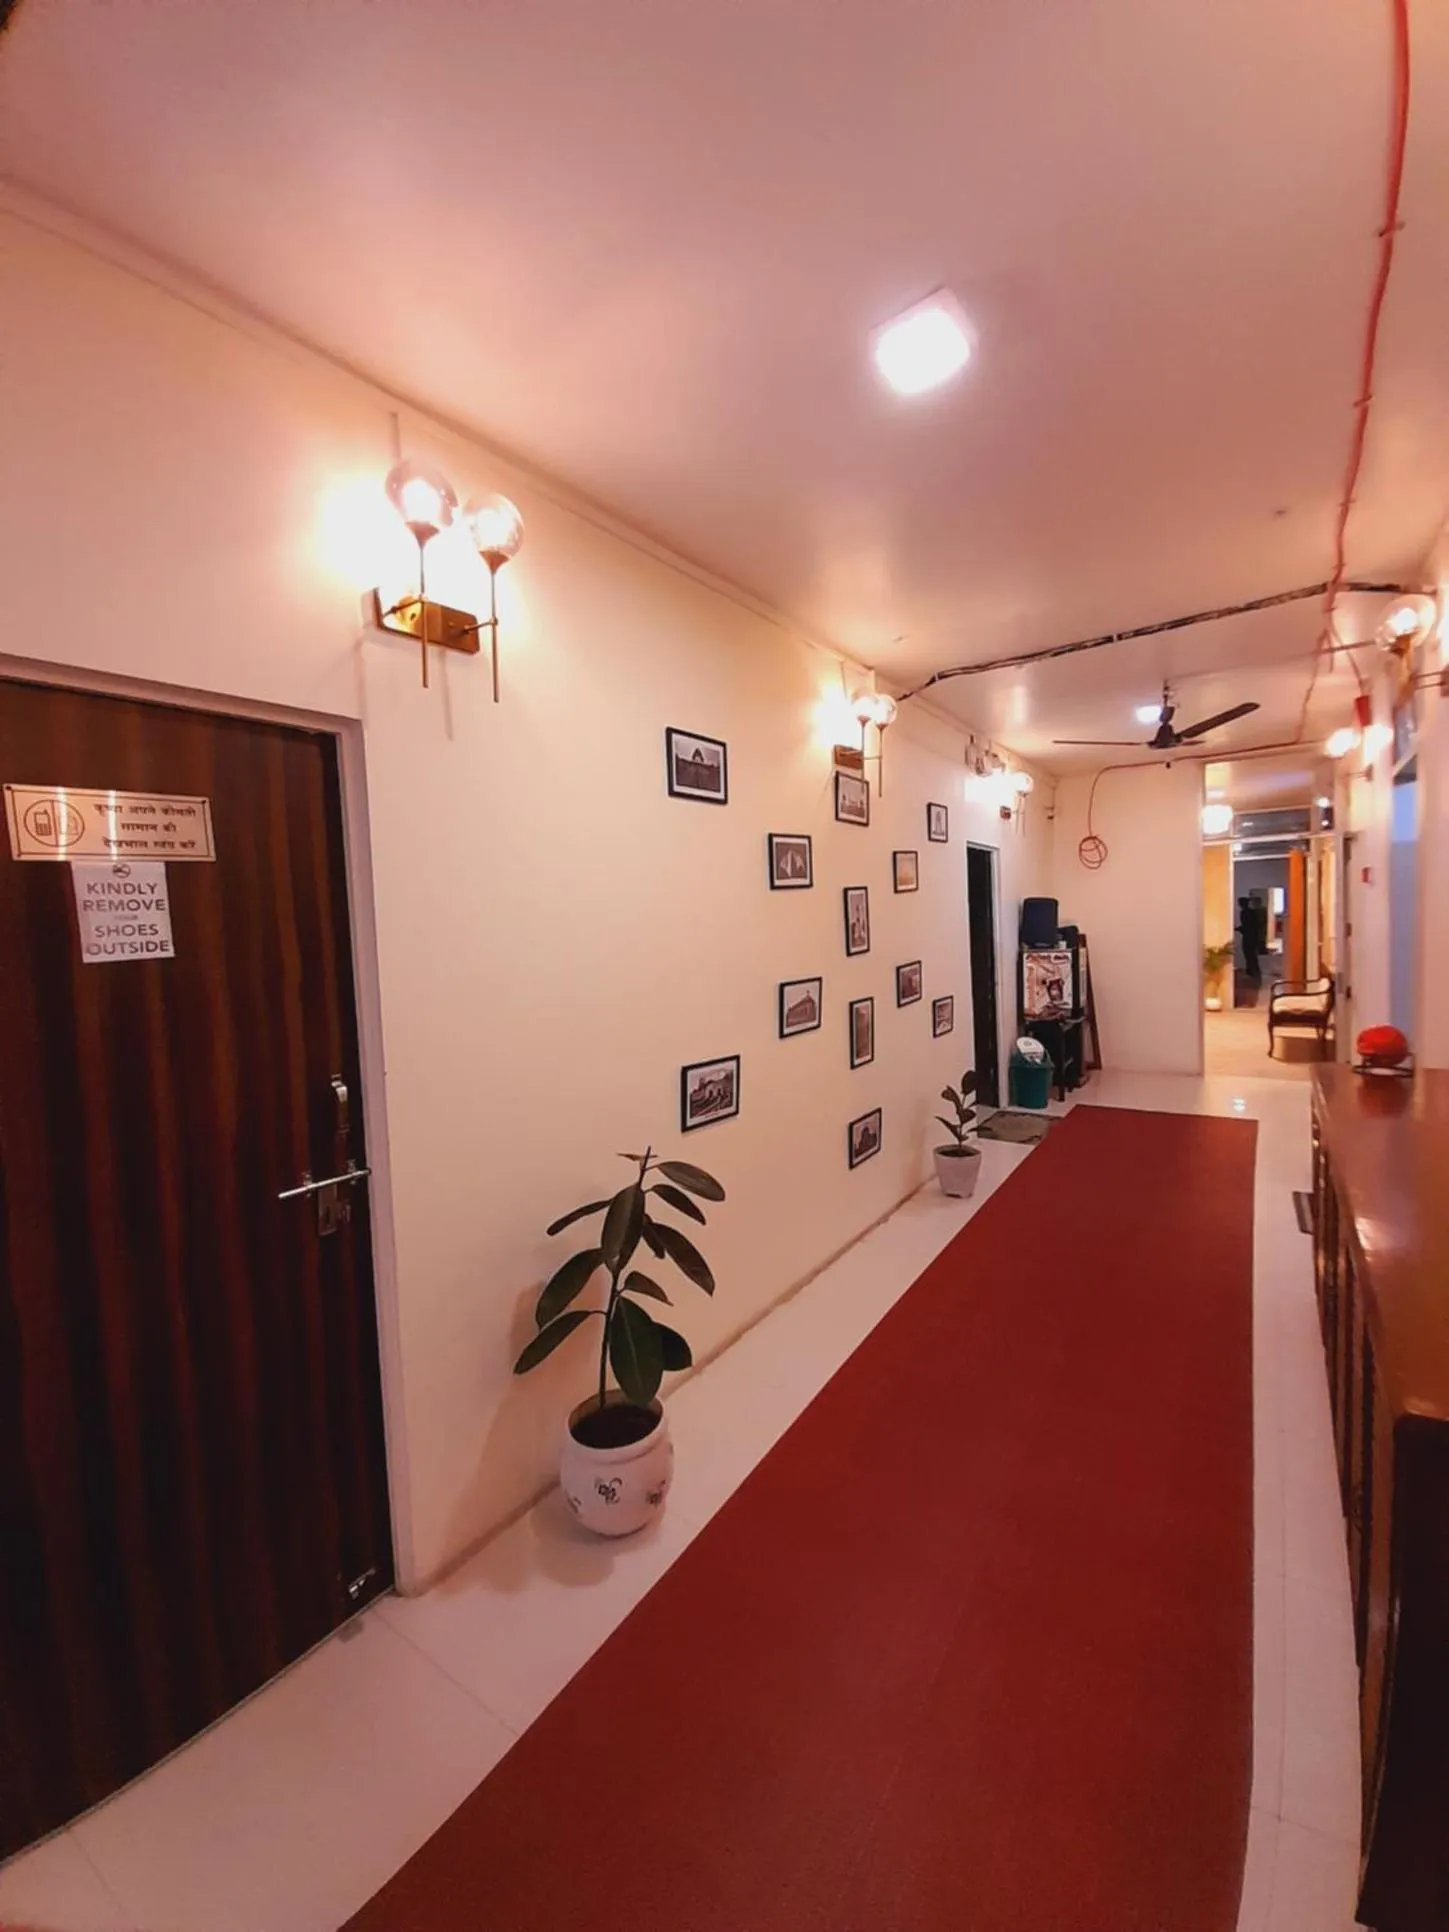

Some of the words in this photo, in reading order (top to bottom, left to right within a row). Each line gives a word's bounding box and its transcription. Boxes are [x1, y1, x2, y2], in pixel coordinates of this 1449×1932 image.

[86, 882, 158, 895] KINDLY
[82, 898, 166, 912] REMOVE
[94, 924, 159, 938] SHOES
[85, 940, 170, 956] OUTSIDE
